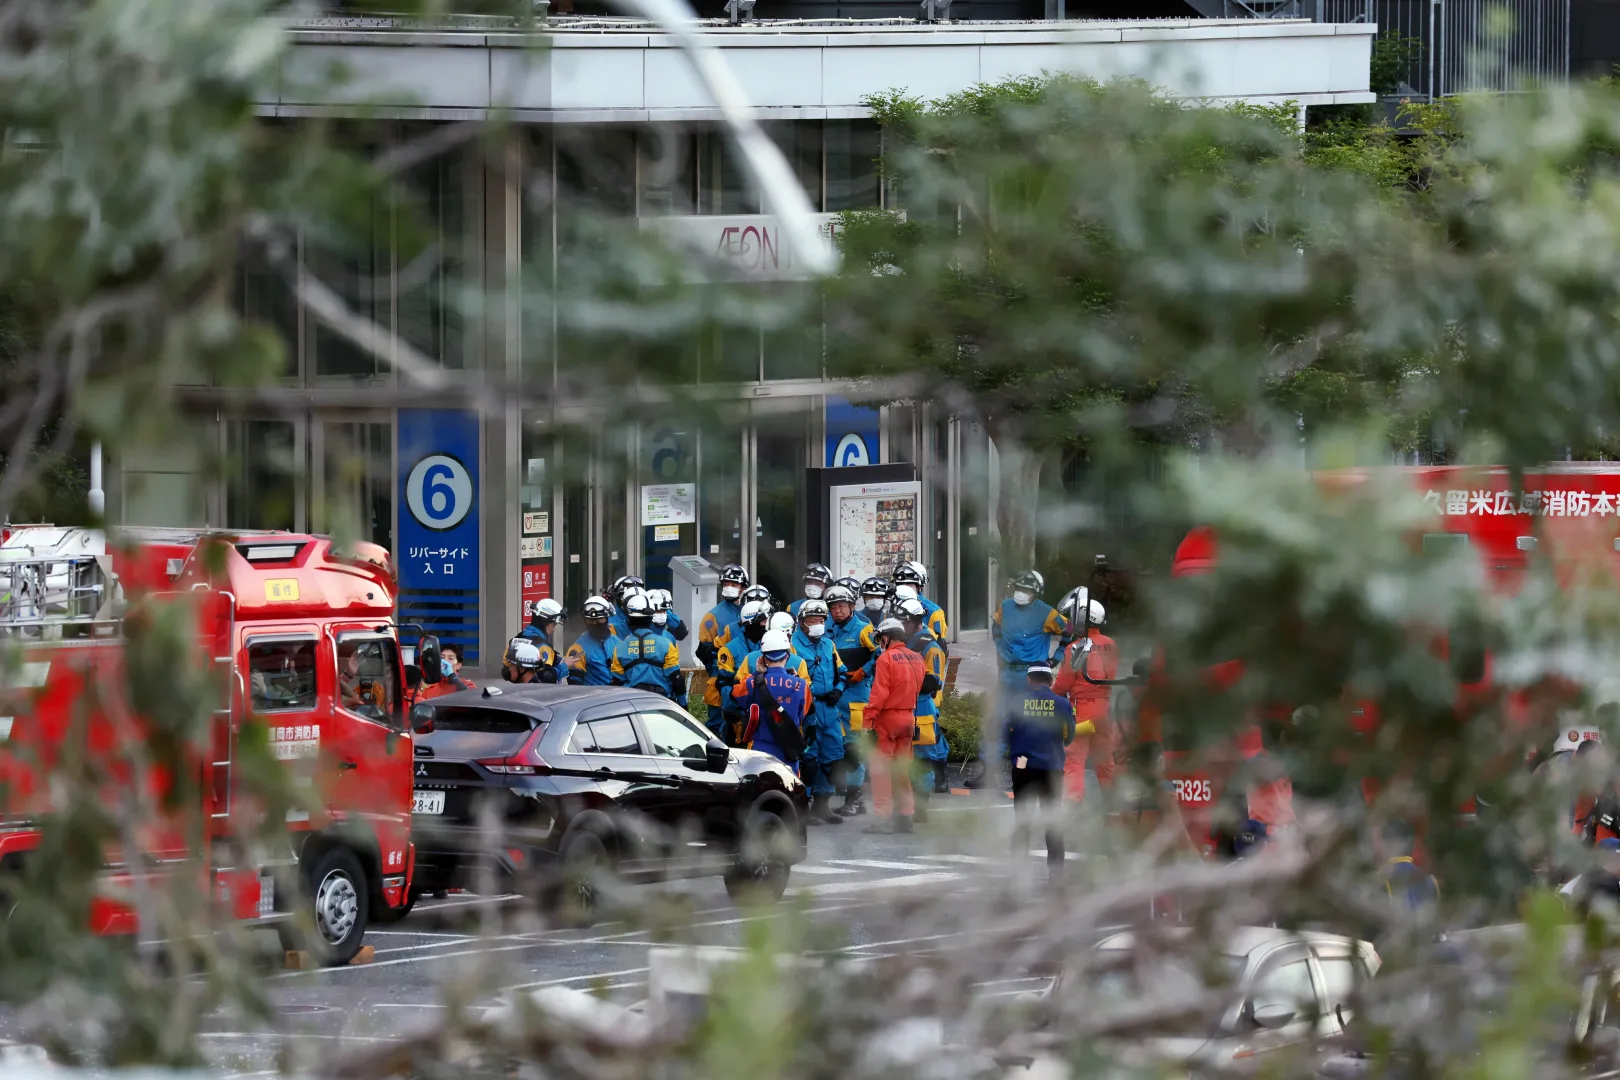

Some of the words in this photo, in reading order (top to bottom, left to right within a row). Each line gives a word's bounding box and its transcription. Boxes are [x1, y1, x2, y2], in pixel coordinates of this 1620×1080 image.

[422, 464, 456, 520] 6
[1421, 490, 1620, 518] 久留米広域消防本
[410, 547, 469, 559] リバーサイド
[628, 646, 656, 655] POICE
[750, 677, 803, 692] PLICE
[1023, 699, 1055, 711] POLICE
